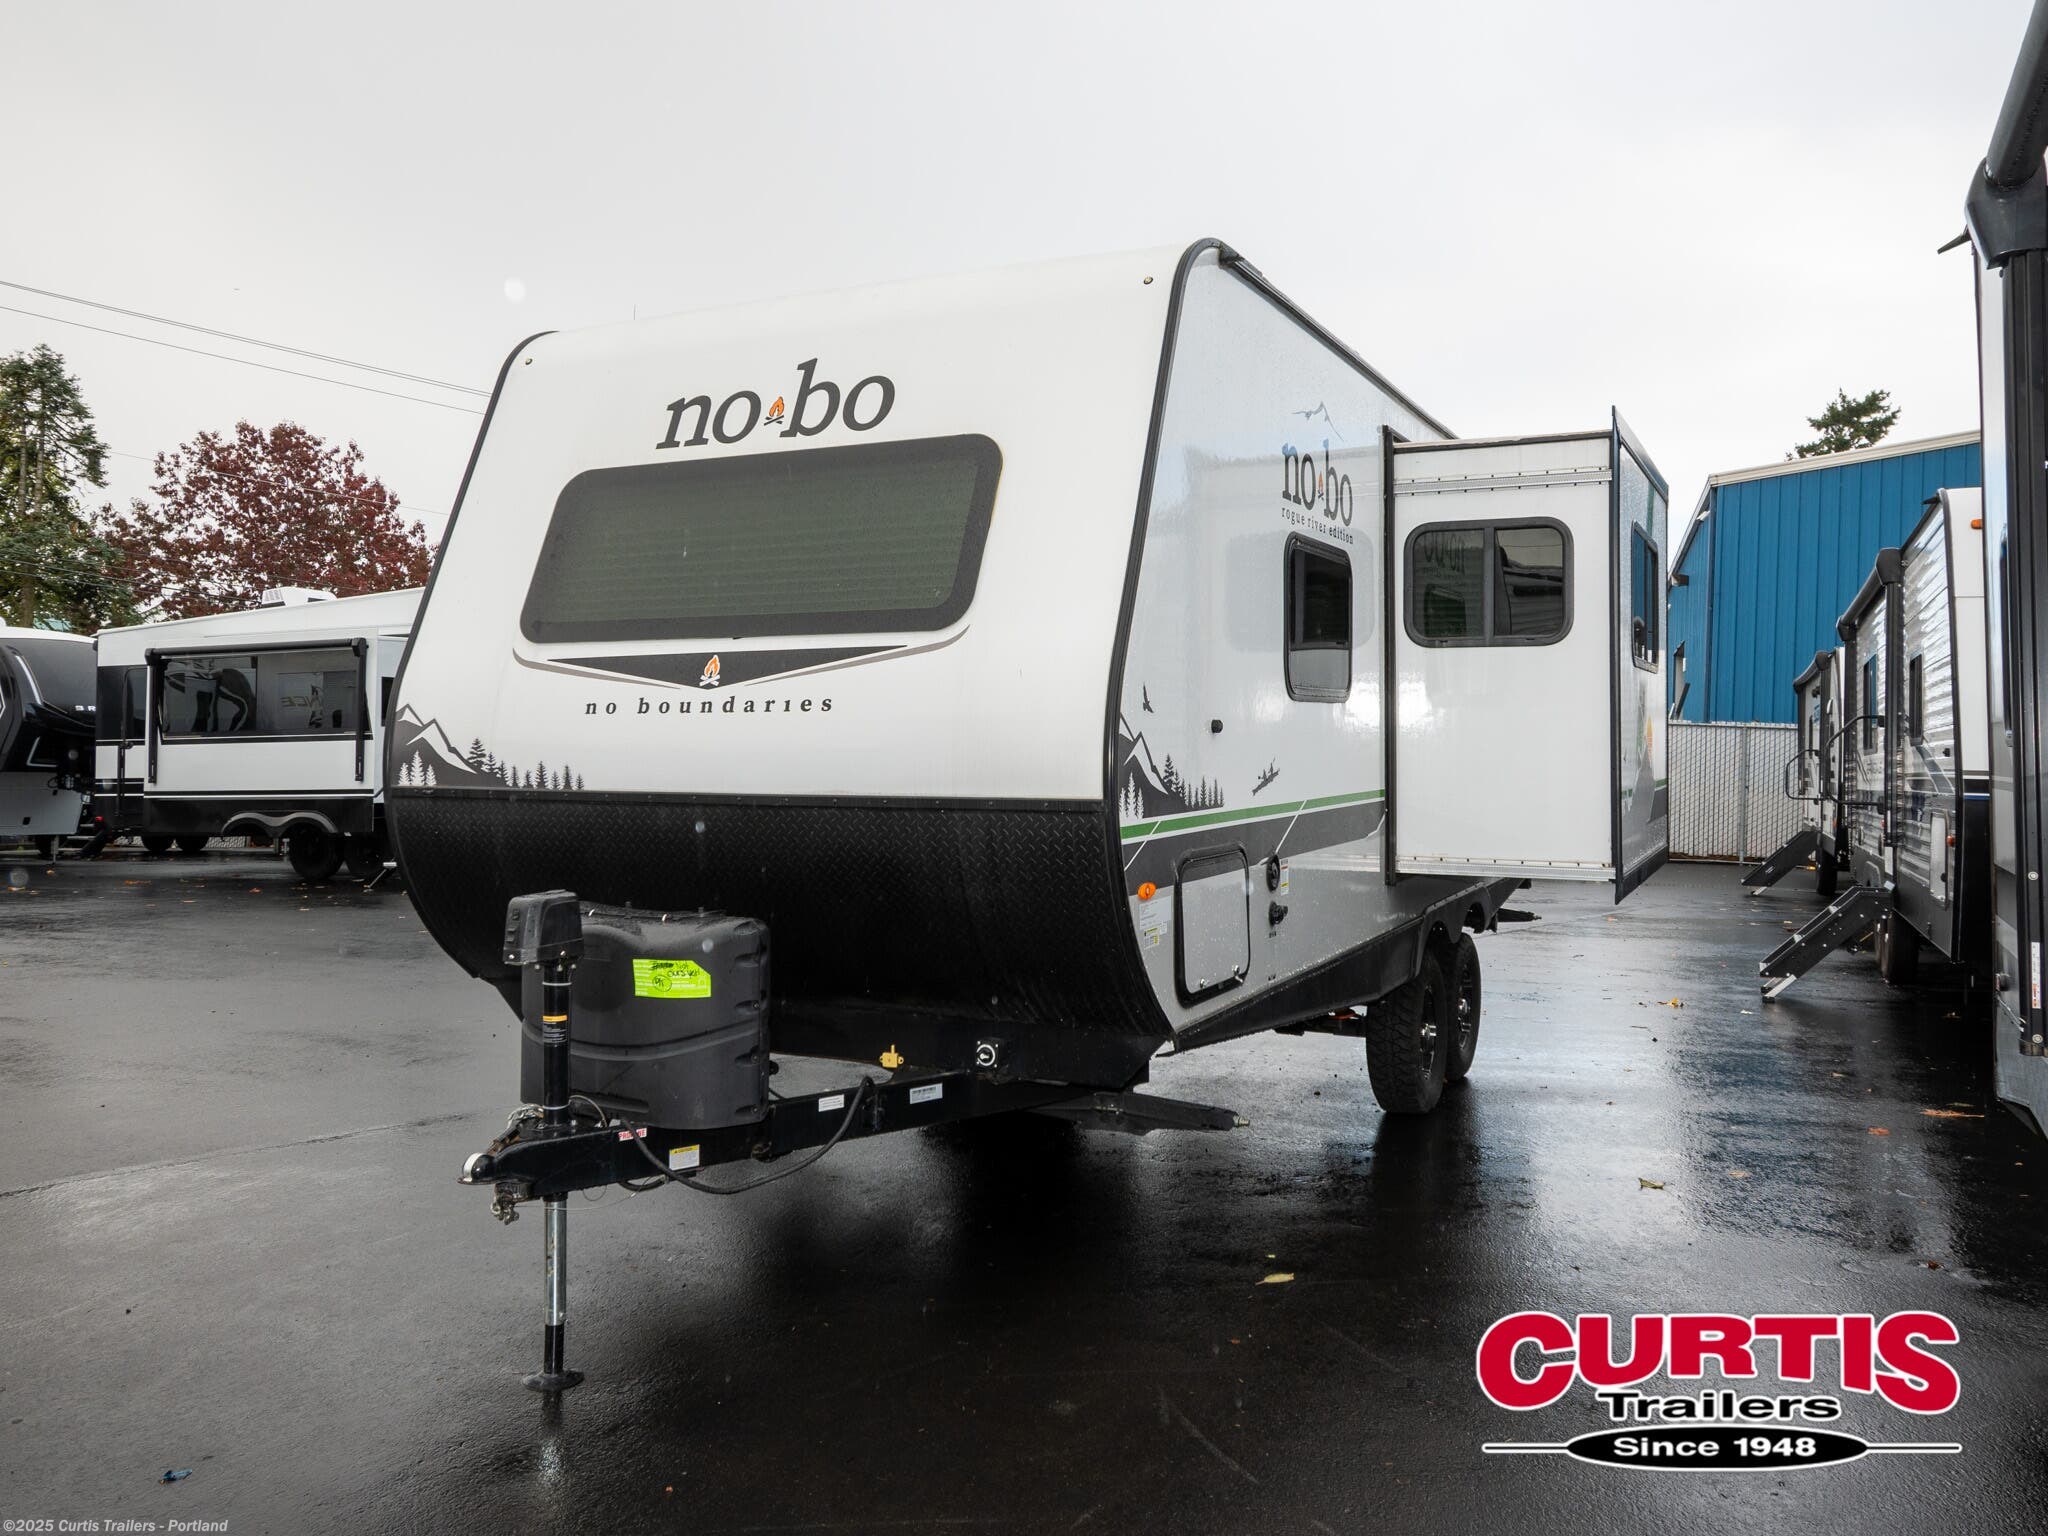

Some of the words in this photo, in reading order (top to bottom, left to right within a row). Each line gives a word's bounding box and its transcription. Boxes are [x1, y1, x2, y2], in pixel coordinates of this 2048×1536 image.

[1281, 508, 1305, 525] rogue
[1307, 516, 1326, 533] river
[1328, 525, 1354, 544] edition
[585, 701, 617, 715] no
[637, 696, 832, 714] boundaries
